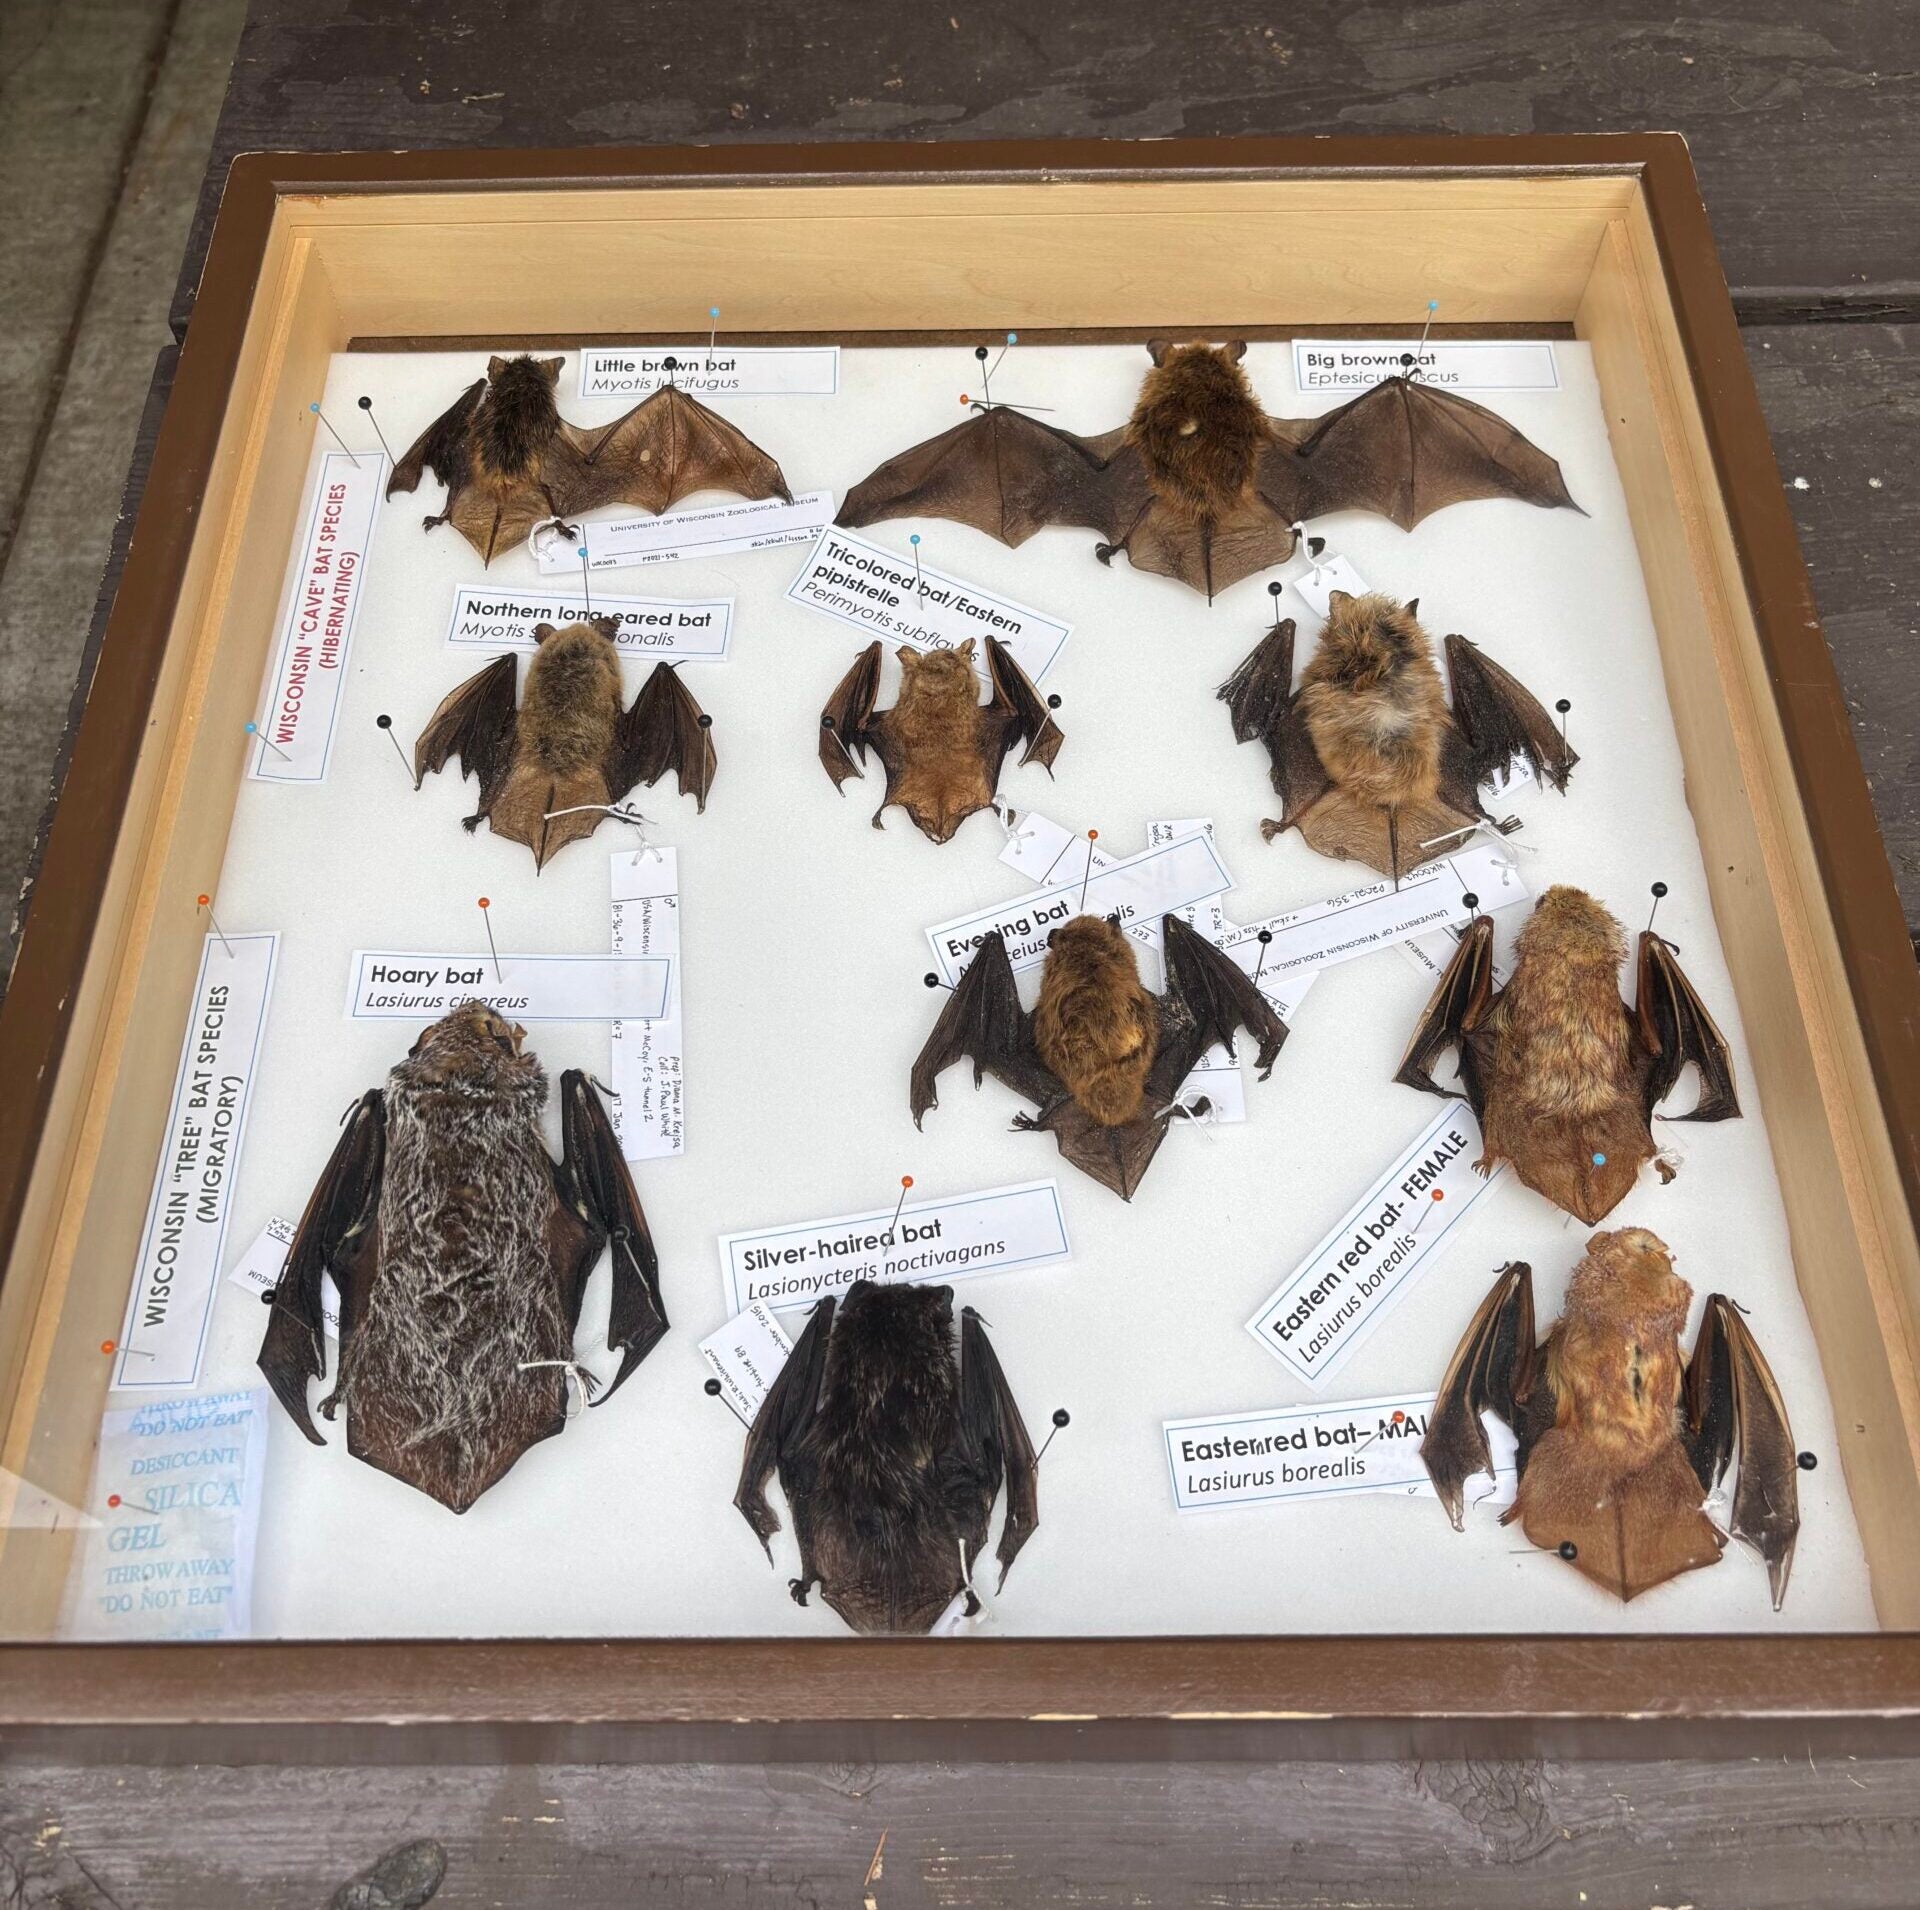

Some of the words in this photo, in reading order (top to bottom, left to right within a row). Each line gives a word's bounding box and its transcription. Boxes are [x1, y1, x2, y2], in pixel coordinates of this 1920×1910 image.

[595, 359, 635, 373] Little
[705, 358, 737, 372] bat
[1307, 353, 1335, 369] Big
[1341, 353, 1400, 367] brown
[592, 376, 651, 392] Myotis
[319, 483, 347, 543] SPECIES
[610, 520, 665, 534] UNIVERSITY
[666, 517, 675, 527] OF
[675, 511, 726, 525] WISCONSIN
[727, 503, 780, 517] ZOOLOGICAL
[313, 546, 330, 575] BAT
[812, 564, 900, 608] pipistrelle
[826, 541, 917, 591] Tricolored
[916, 580, 1022, 635] bat/Eastern
[318, 550, 361, 670] (HIBERNATING)
[466, 600, 552, 620] Northern
[678, 612, 712, 628] bat
[801, 581, 894, 628] Perimyotis
[460, 622, 525, 640] Myotis
[276, 645, 313, 744] WISCONSIN
[1032, 900, 1070, 926] bat
[1400, 908, 1449, 933] UNIVERSITY
[1327, 931, 1380, 957] WISCONSIN
[1380, 926, 1394, 937] OF
[1271, 950, 1327, 973] ZOOLOGICAL
[370, 965, 439, 988] Hoary
[445, 967, 484, 985] bat
[366, 992, 444, 1008] Lasiurus
[197, 984, 230, 1064] SPECIES
[188, 1070, 213, 1108] BAT
[195, 1075, 244, 1224] (MIGRATORY)
[743, 1226, 896, 1271] Silver-haired
[902, 1218, 943, 1243] bat
[1271, 1271, 1343, 1342] Eastern
[1336, 1235, 1373, 1275] red
[1400, 1129, 1469, 1201] FEMALE
[143, 1191, 190, 1328] WISCONSIN
[748, 1260, 878, 1301] Lasionycteris
[884, 1239, 1007, 1276] noctivagans
[1298, 1295, 1363, 1364] Lasiurus
[1355, 1232, 1417, 1299] borealis
[171, 1415, 210, 1434] NOT
[1264, 1428, 1308, 1453] red
[130, 1447, 240, 1476] DESICCANT
[1188, 1470, 1275, 1494] Lasiurus
[1282, 1456, 1367, 1484] borealis
[145, 1478, 243, 1513] SILICA
[107, 1523, 168, 1552] GEL
[104, 1561, 175, 1586] THROW
[175, 1558, 235, 1579] AWAY
[140, 1588, 182, 1611] NOT
